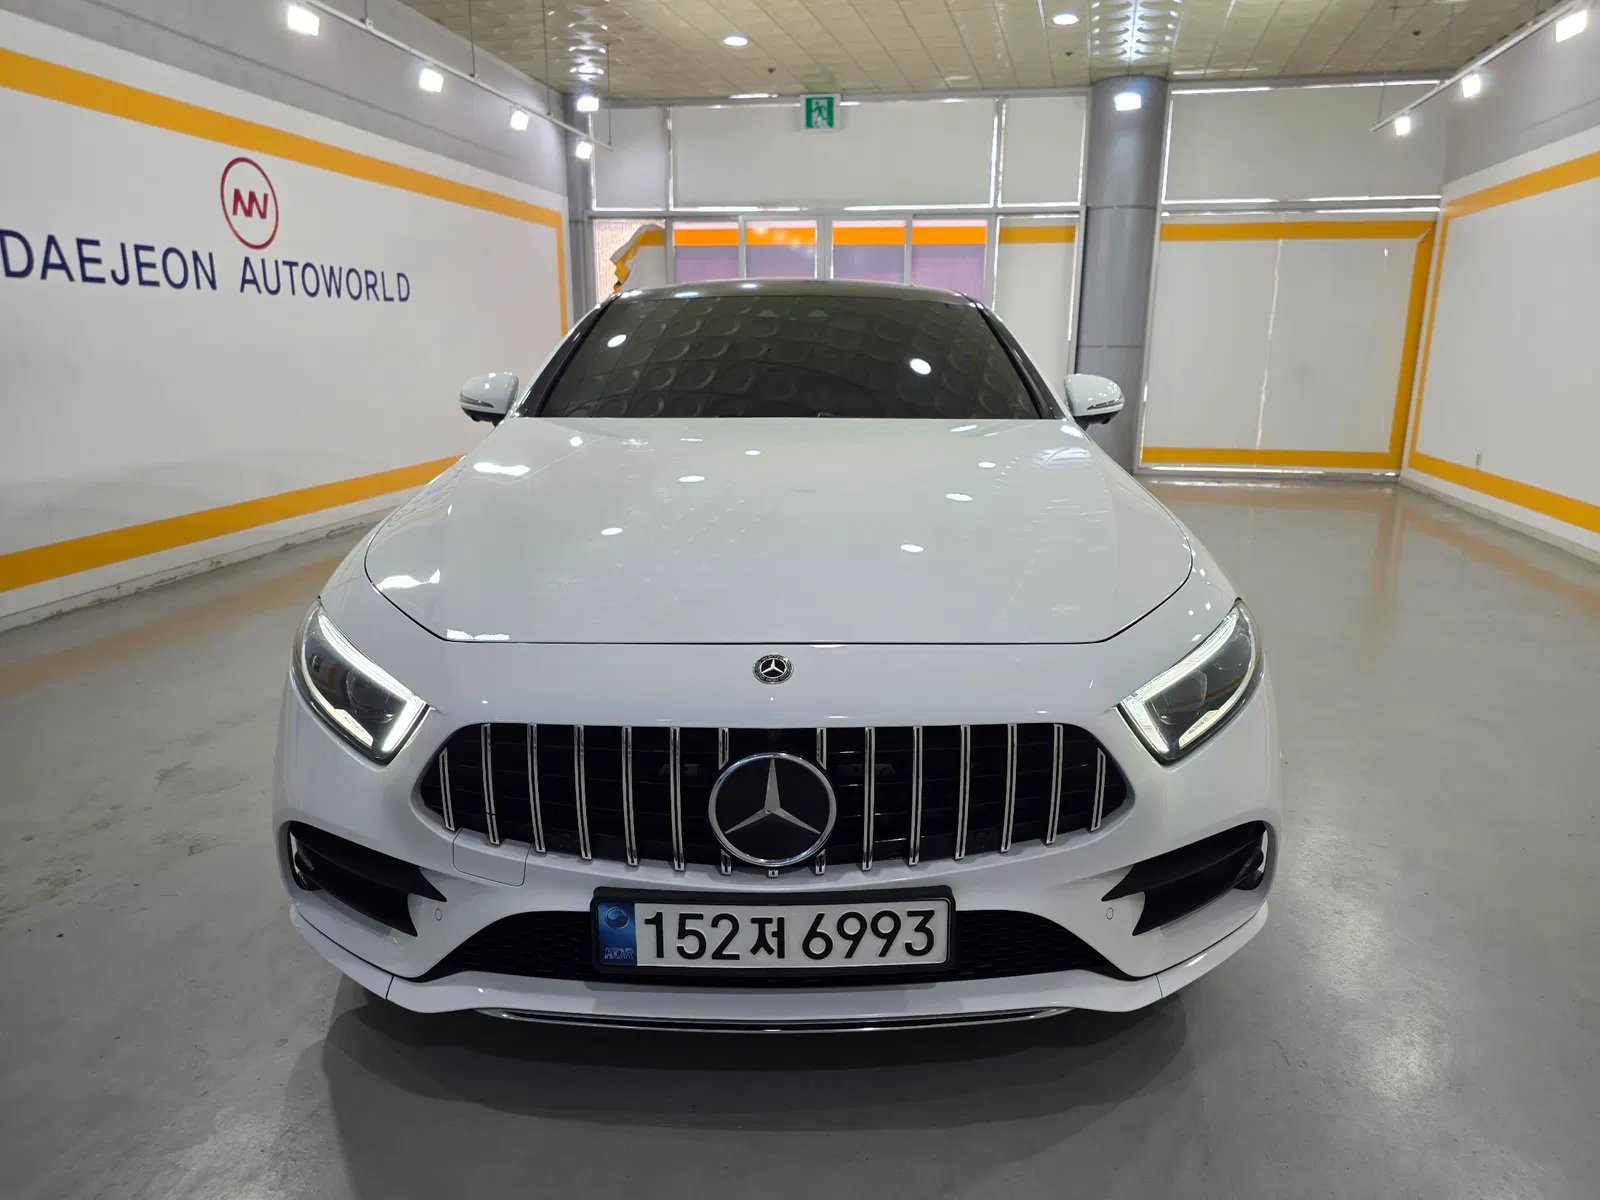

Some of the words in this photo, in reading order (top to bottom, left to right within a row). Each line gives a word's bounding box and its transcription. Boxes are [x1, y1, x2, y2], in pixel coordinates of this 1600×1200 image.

[0, 228, 217, 291] DAEJEON
[240, 256, 411, 303] AUTOWORLD
[604, 946, 635, 960] KOR
[644, 911, 785, 961] 152저
[802, 910, 936, 961] 6993
